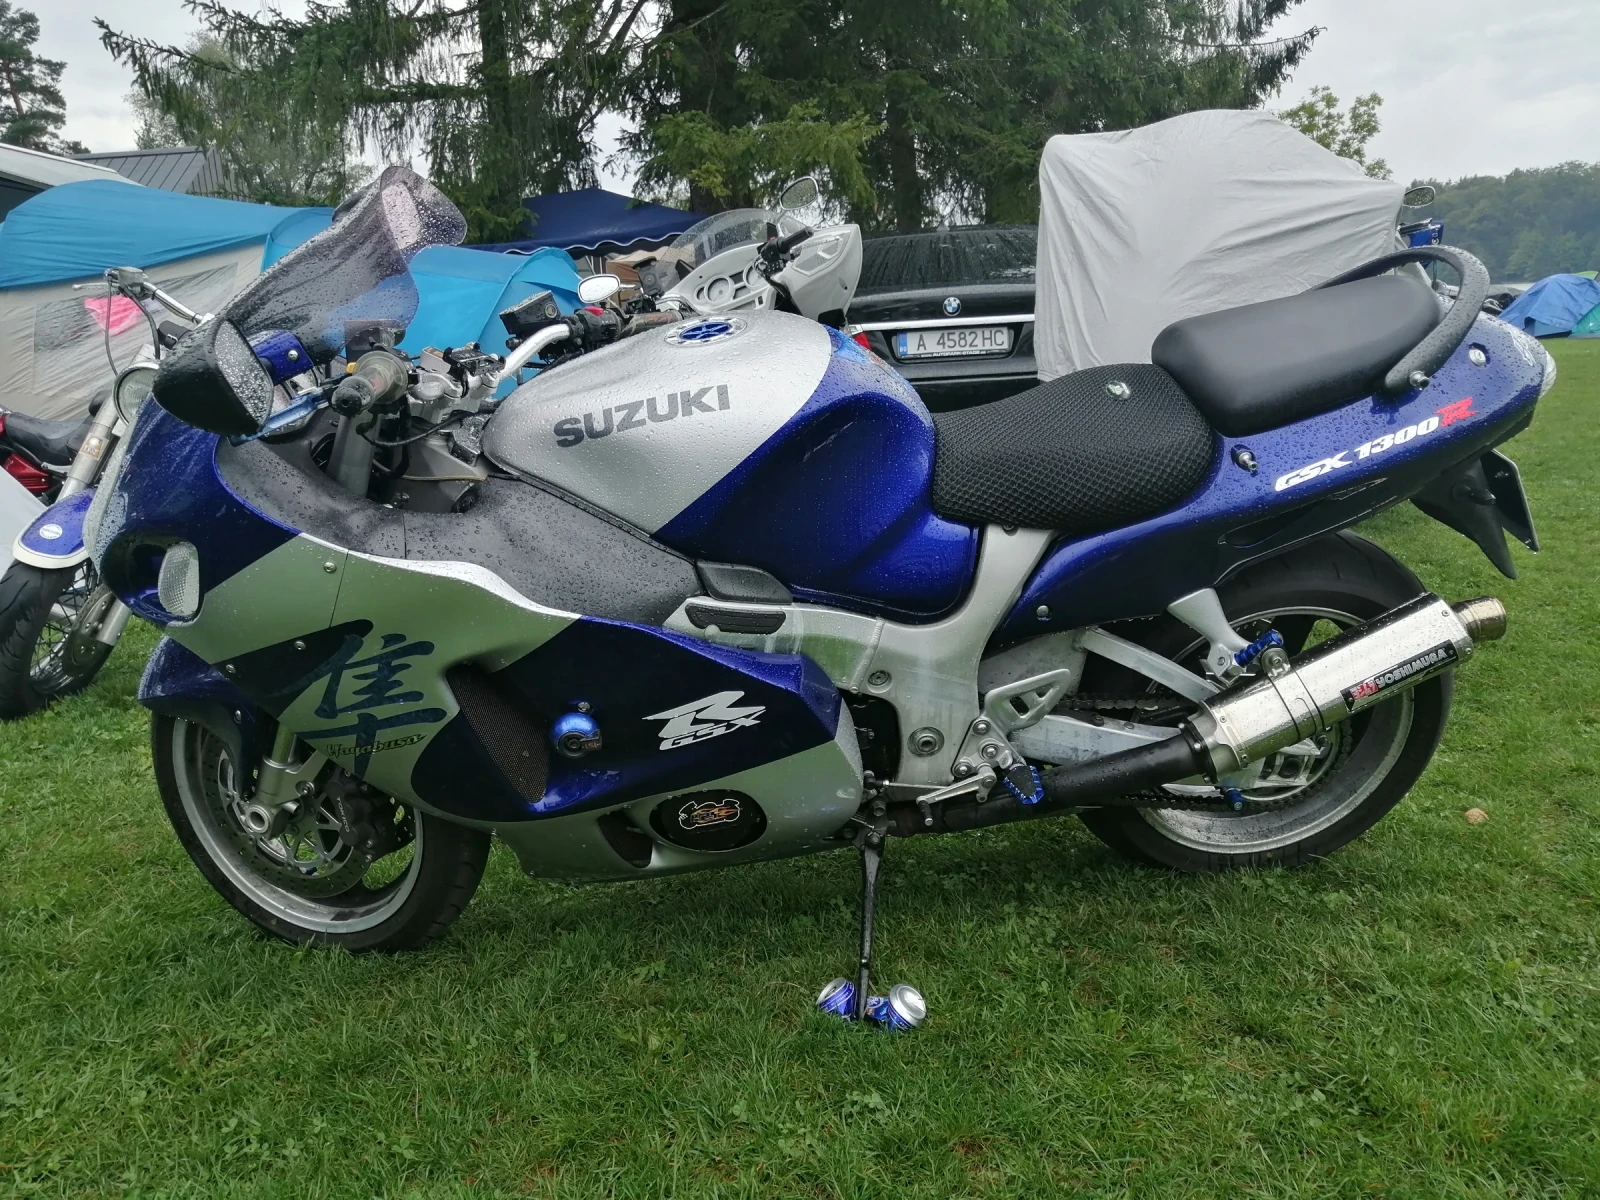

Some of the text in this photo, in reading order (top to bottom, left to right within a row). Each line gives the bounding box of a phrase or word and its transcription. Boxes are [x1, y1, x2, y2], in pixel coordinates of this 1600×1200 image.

[917, 329, 1005, 351] A 4582 HC
[553, 384, 731, 448] SUZUKI
[1275, 450, 1352, 491] GSX
[1374, 648, 1449, 689] YOSHIMURA
